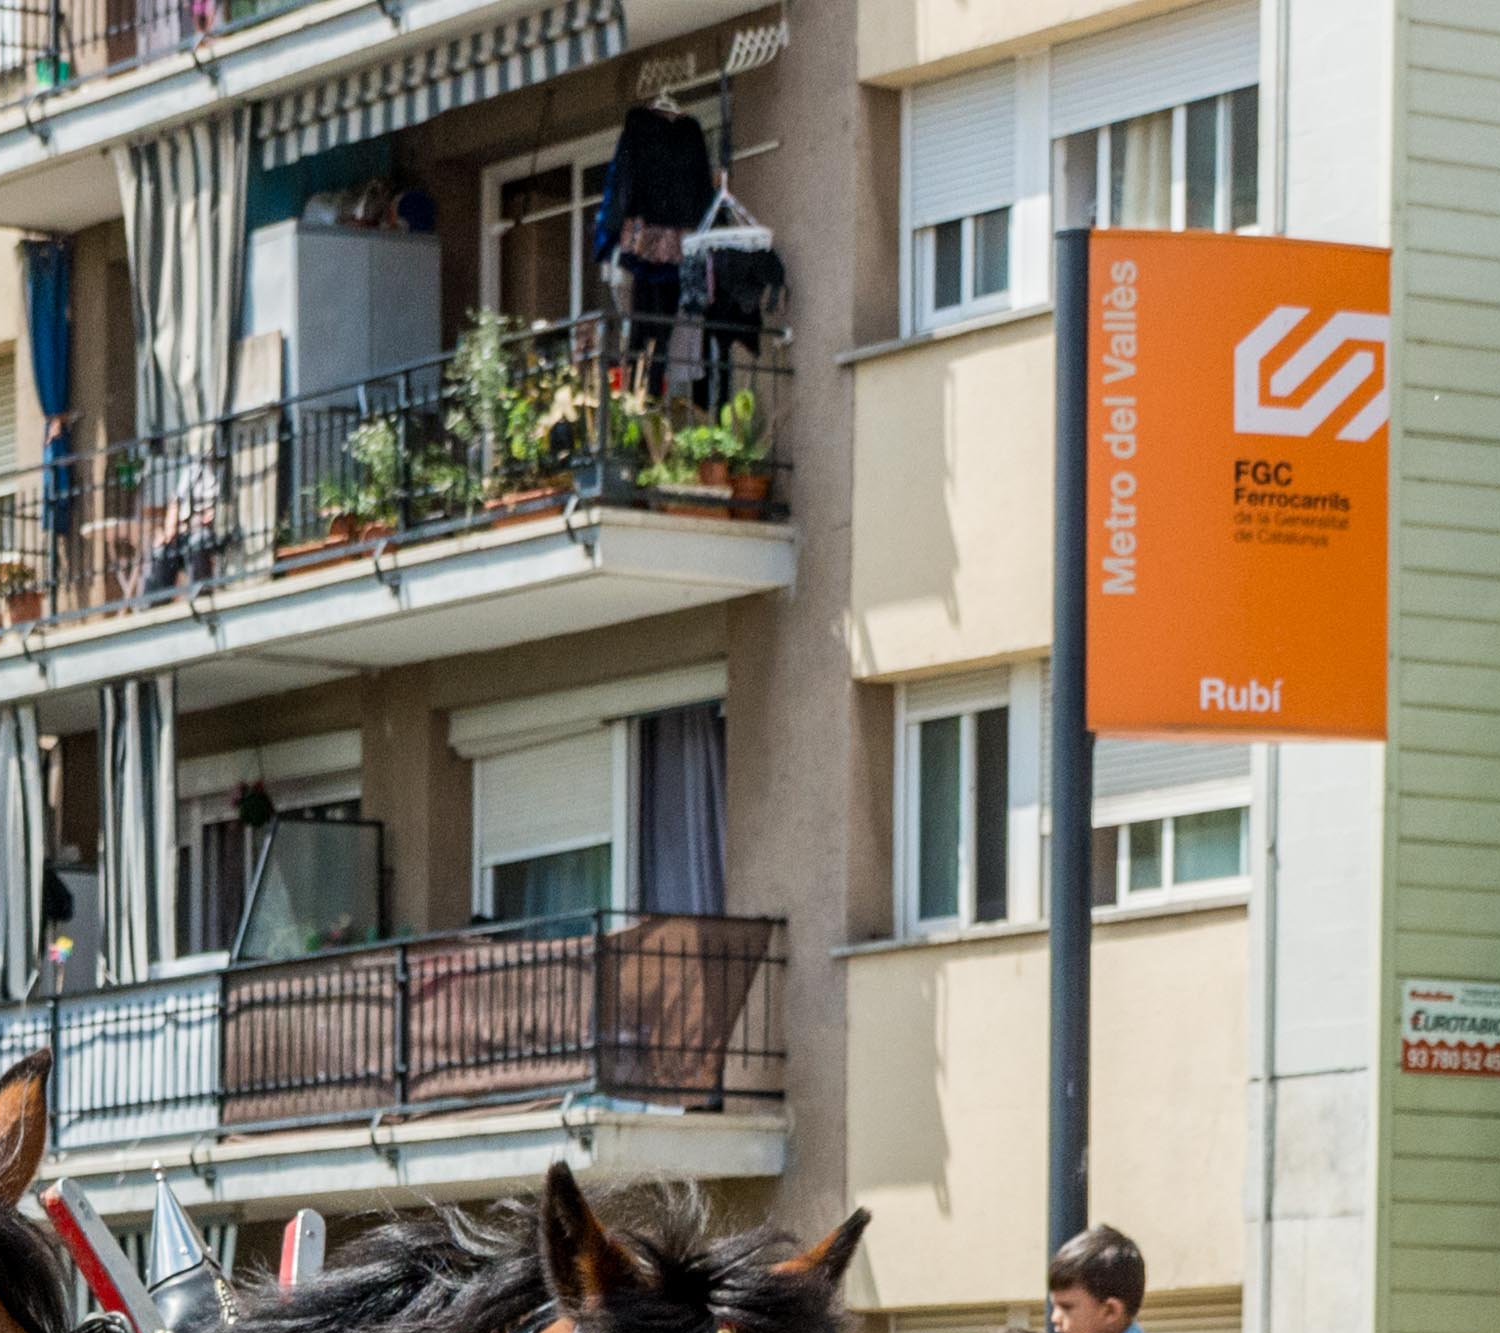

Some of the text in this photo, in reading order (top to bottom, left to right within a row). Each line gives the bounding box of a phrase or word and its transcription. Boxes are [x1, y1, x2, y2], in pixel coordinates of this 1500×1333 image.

[1102, 259, 1137, 595] Metro del Vallès
[1234, 460, 1293, 486] FGC
[1234, 487, 1350, 512] Ferrocarrils
[1200, 678, 1283, 713] Rubí
